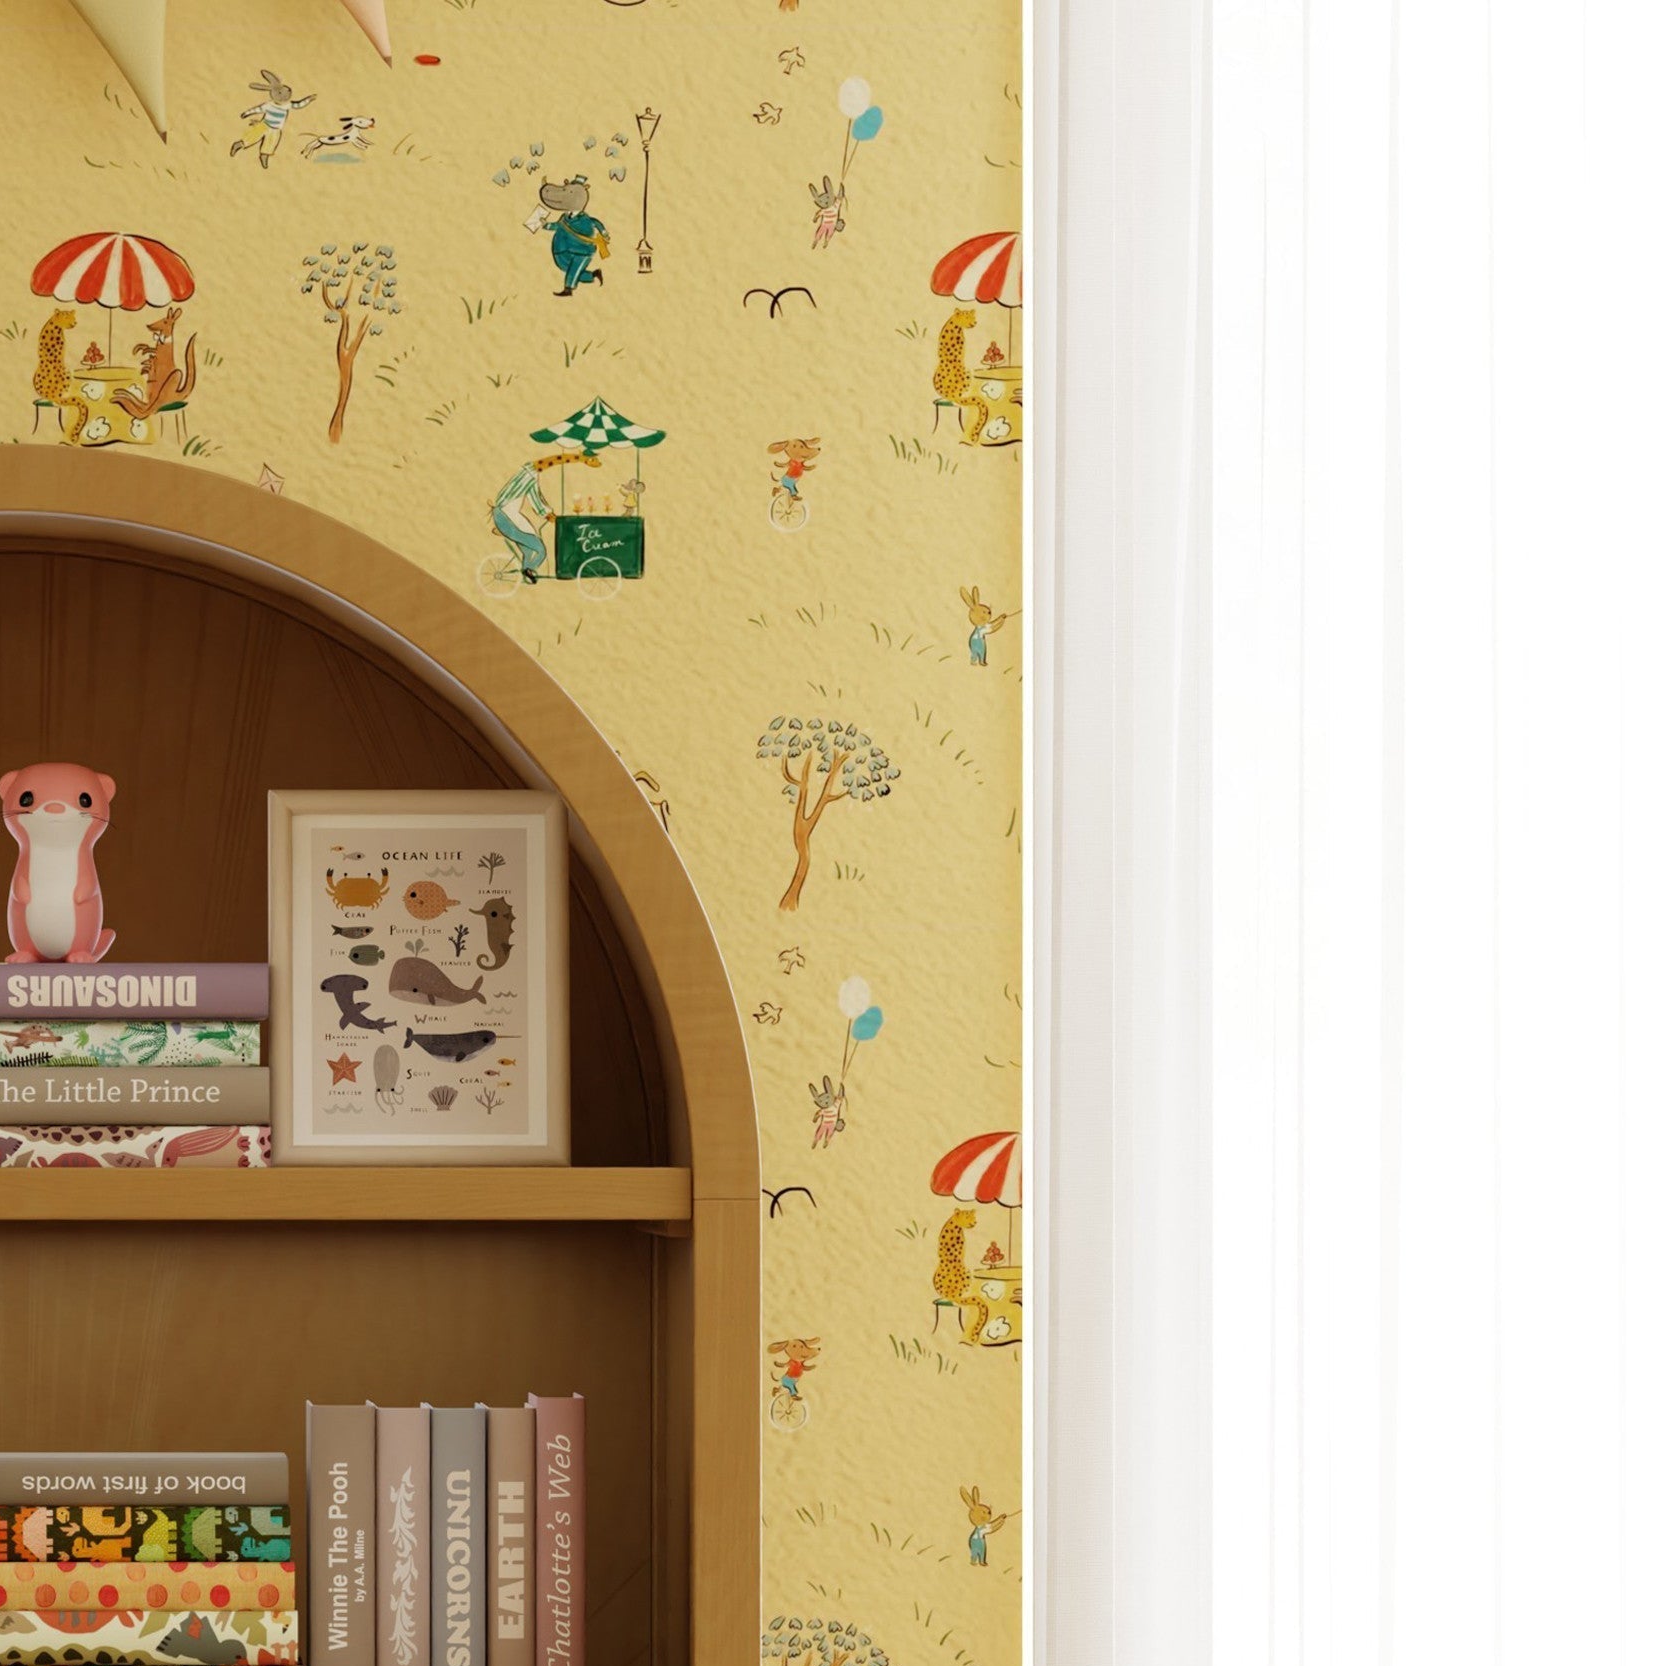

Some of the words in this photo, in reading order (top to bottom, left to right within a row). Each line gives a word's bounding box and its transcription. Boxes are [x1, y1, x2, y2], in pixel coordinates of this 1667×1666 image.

[576, 523, 602, 542] Ice
[581, 539, 624, 553] Cream
[382, 851, 429, 861] OCEAN
[435, 851, 462, 861] LIFE
[7, 975, 197, 1008] DINOSAURS
[45, 1077, 121, 1103] Little
[130, 1078, 221, 1103] Prince
[547, 1434, 571, 1500] Web
[22, 1475, 96, 1494] words
[103, 1475, 148, 1494] first
[154, 1475, 179, 1494] of
[186, 1475, 246, 1494] book
[328, 1462, 348, 1519] Pooh
[328, 1526, 348, 1568] The
[354, 1529, 365, 1560] Milne
[498, 1481, 525, 1639] EARTH
[354, 1562, 364, 1587] A.A.
[354, 1588, 366, 1602] by
[328, 1574, 348, 1650] Winnie
